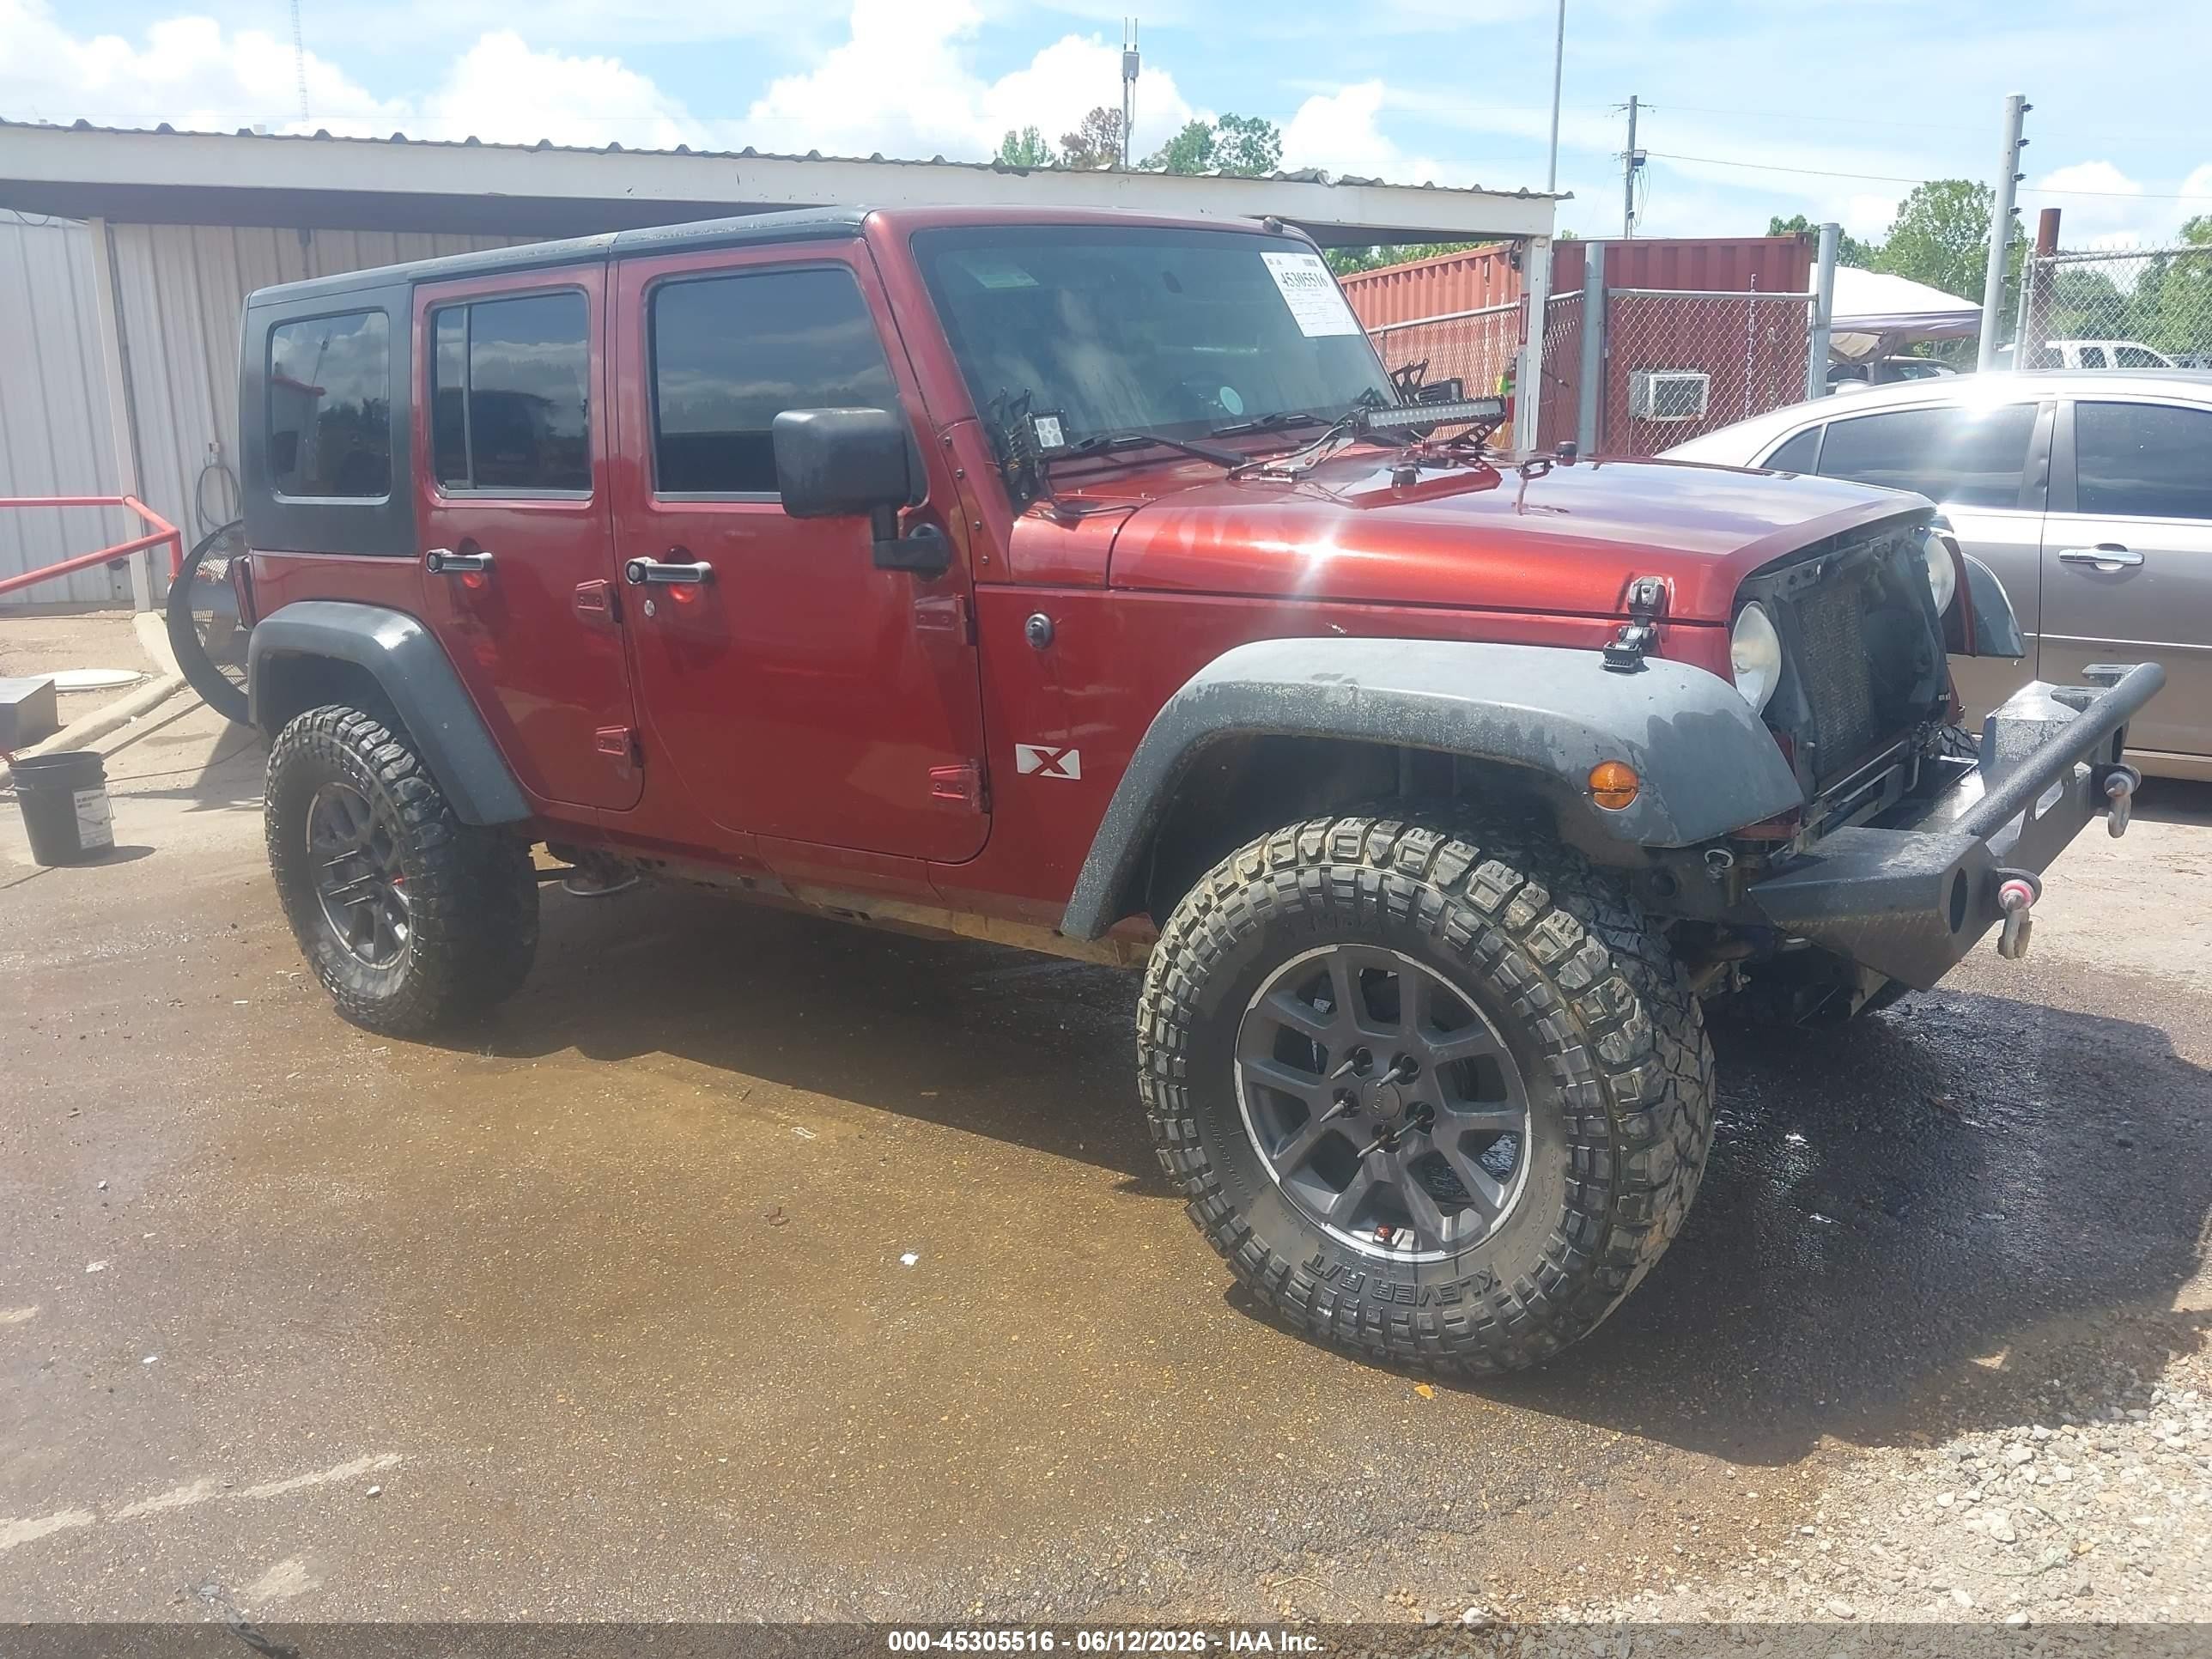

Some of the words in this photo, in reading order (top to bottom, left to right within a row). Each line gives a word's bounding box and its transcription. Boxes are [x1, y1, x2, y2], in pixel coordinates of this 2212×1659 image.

[1280, 271, 1328, 288] 45305516
[1301, 1251, 1366, 1293] R/T
[1371, 1261, 1502, 1306] KLEVER
